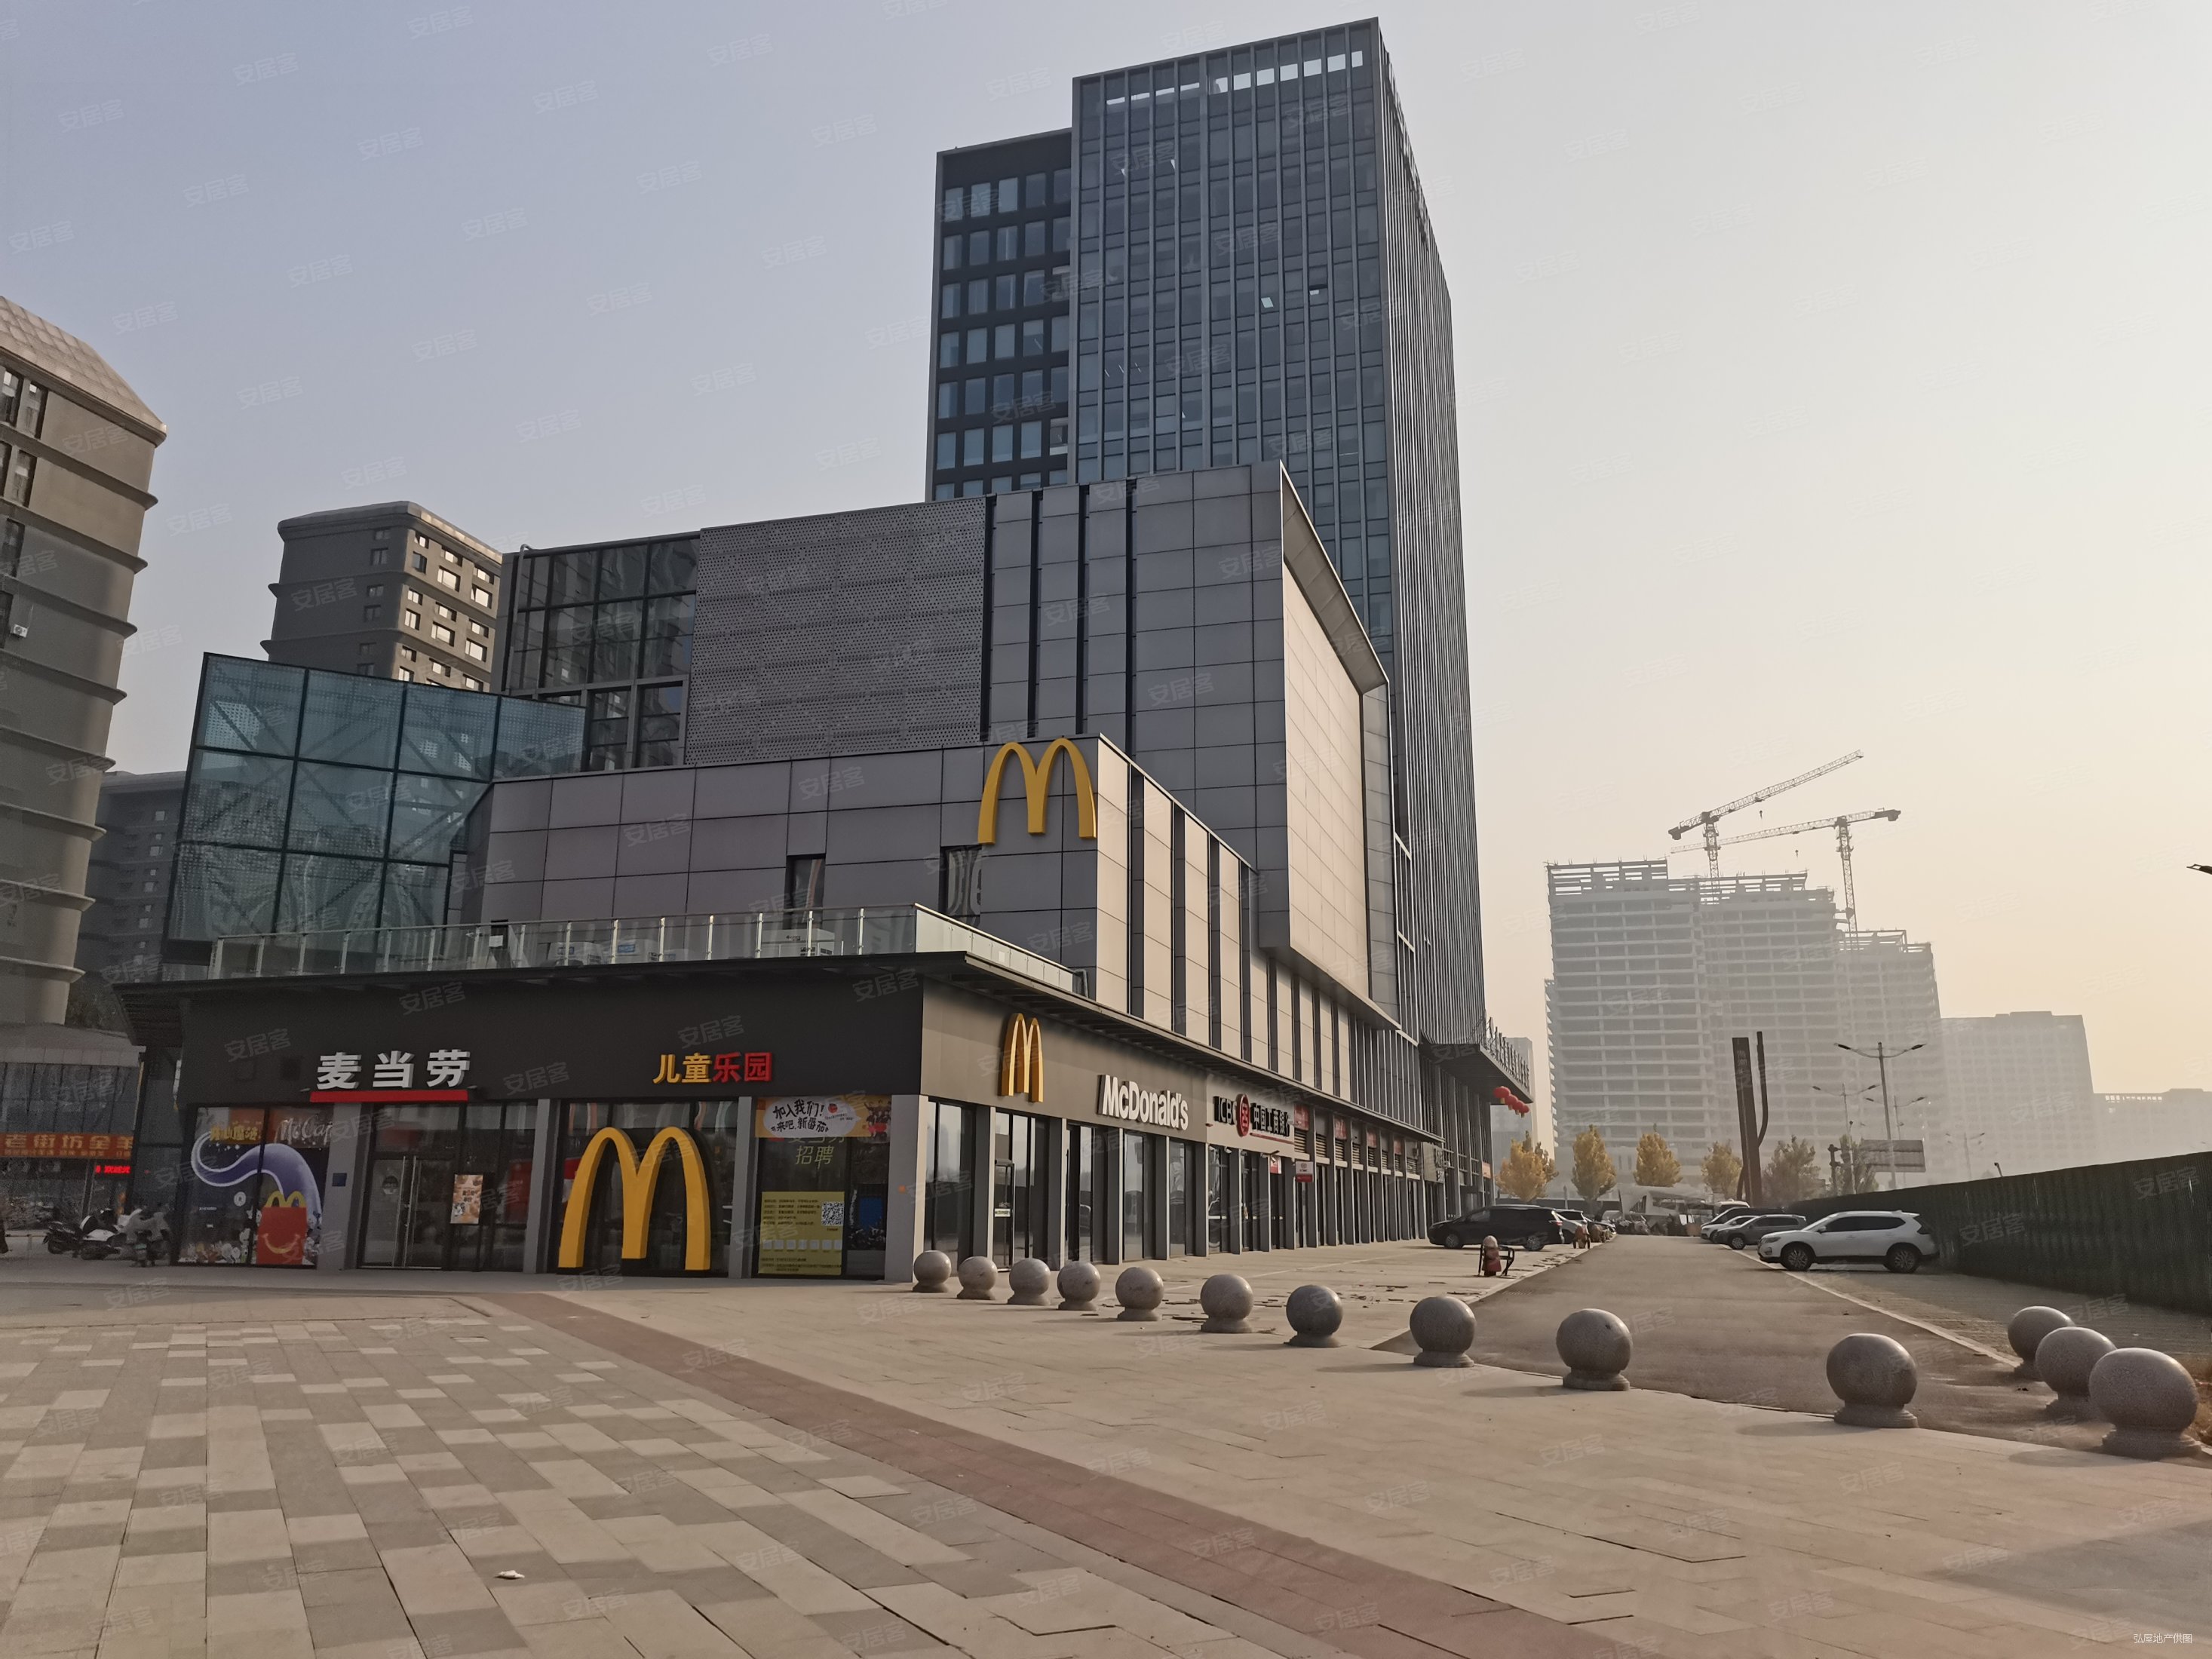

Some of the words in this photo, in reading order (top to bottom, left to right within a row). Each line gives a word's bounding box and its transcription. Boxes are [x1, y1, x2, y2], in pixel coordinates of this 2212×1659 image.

[317, 1049, 471, 1090] 麦当劳
[653, 1052, 772, 1085] 儿童乐园
[772, 1099, 824, 1120] 加入我们!
[1099, 1074, 1189, 1131] McDonald's
[795, 1145, 835, 1170] 招聘
